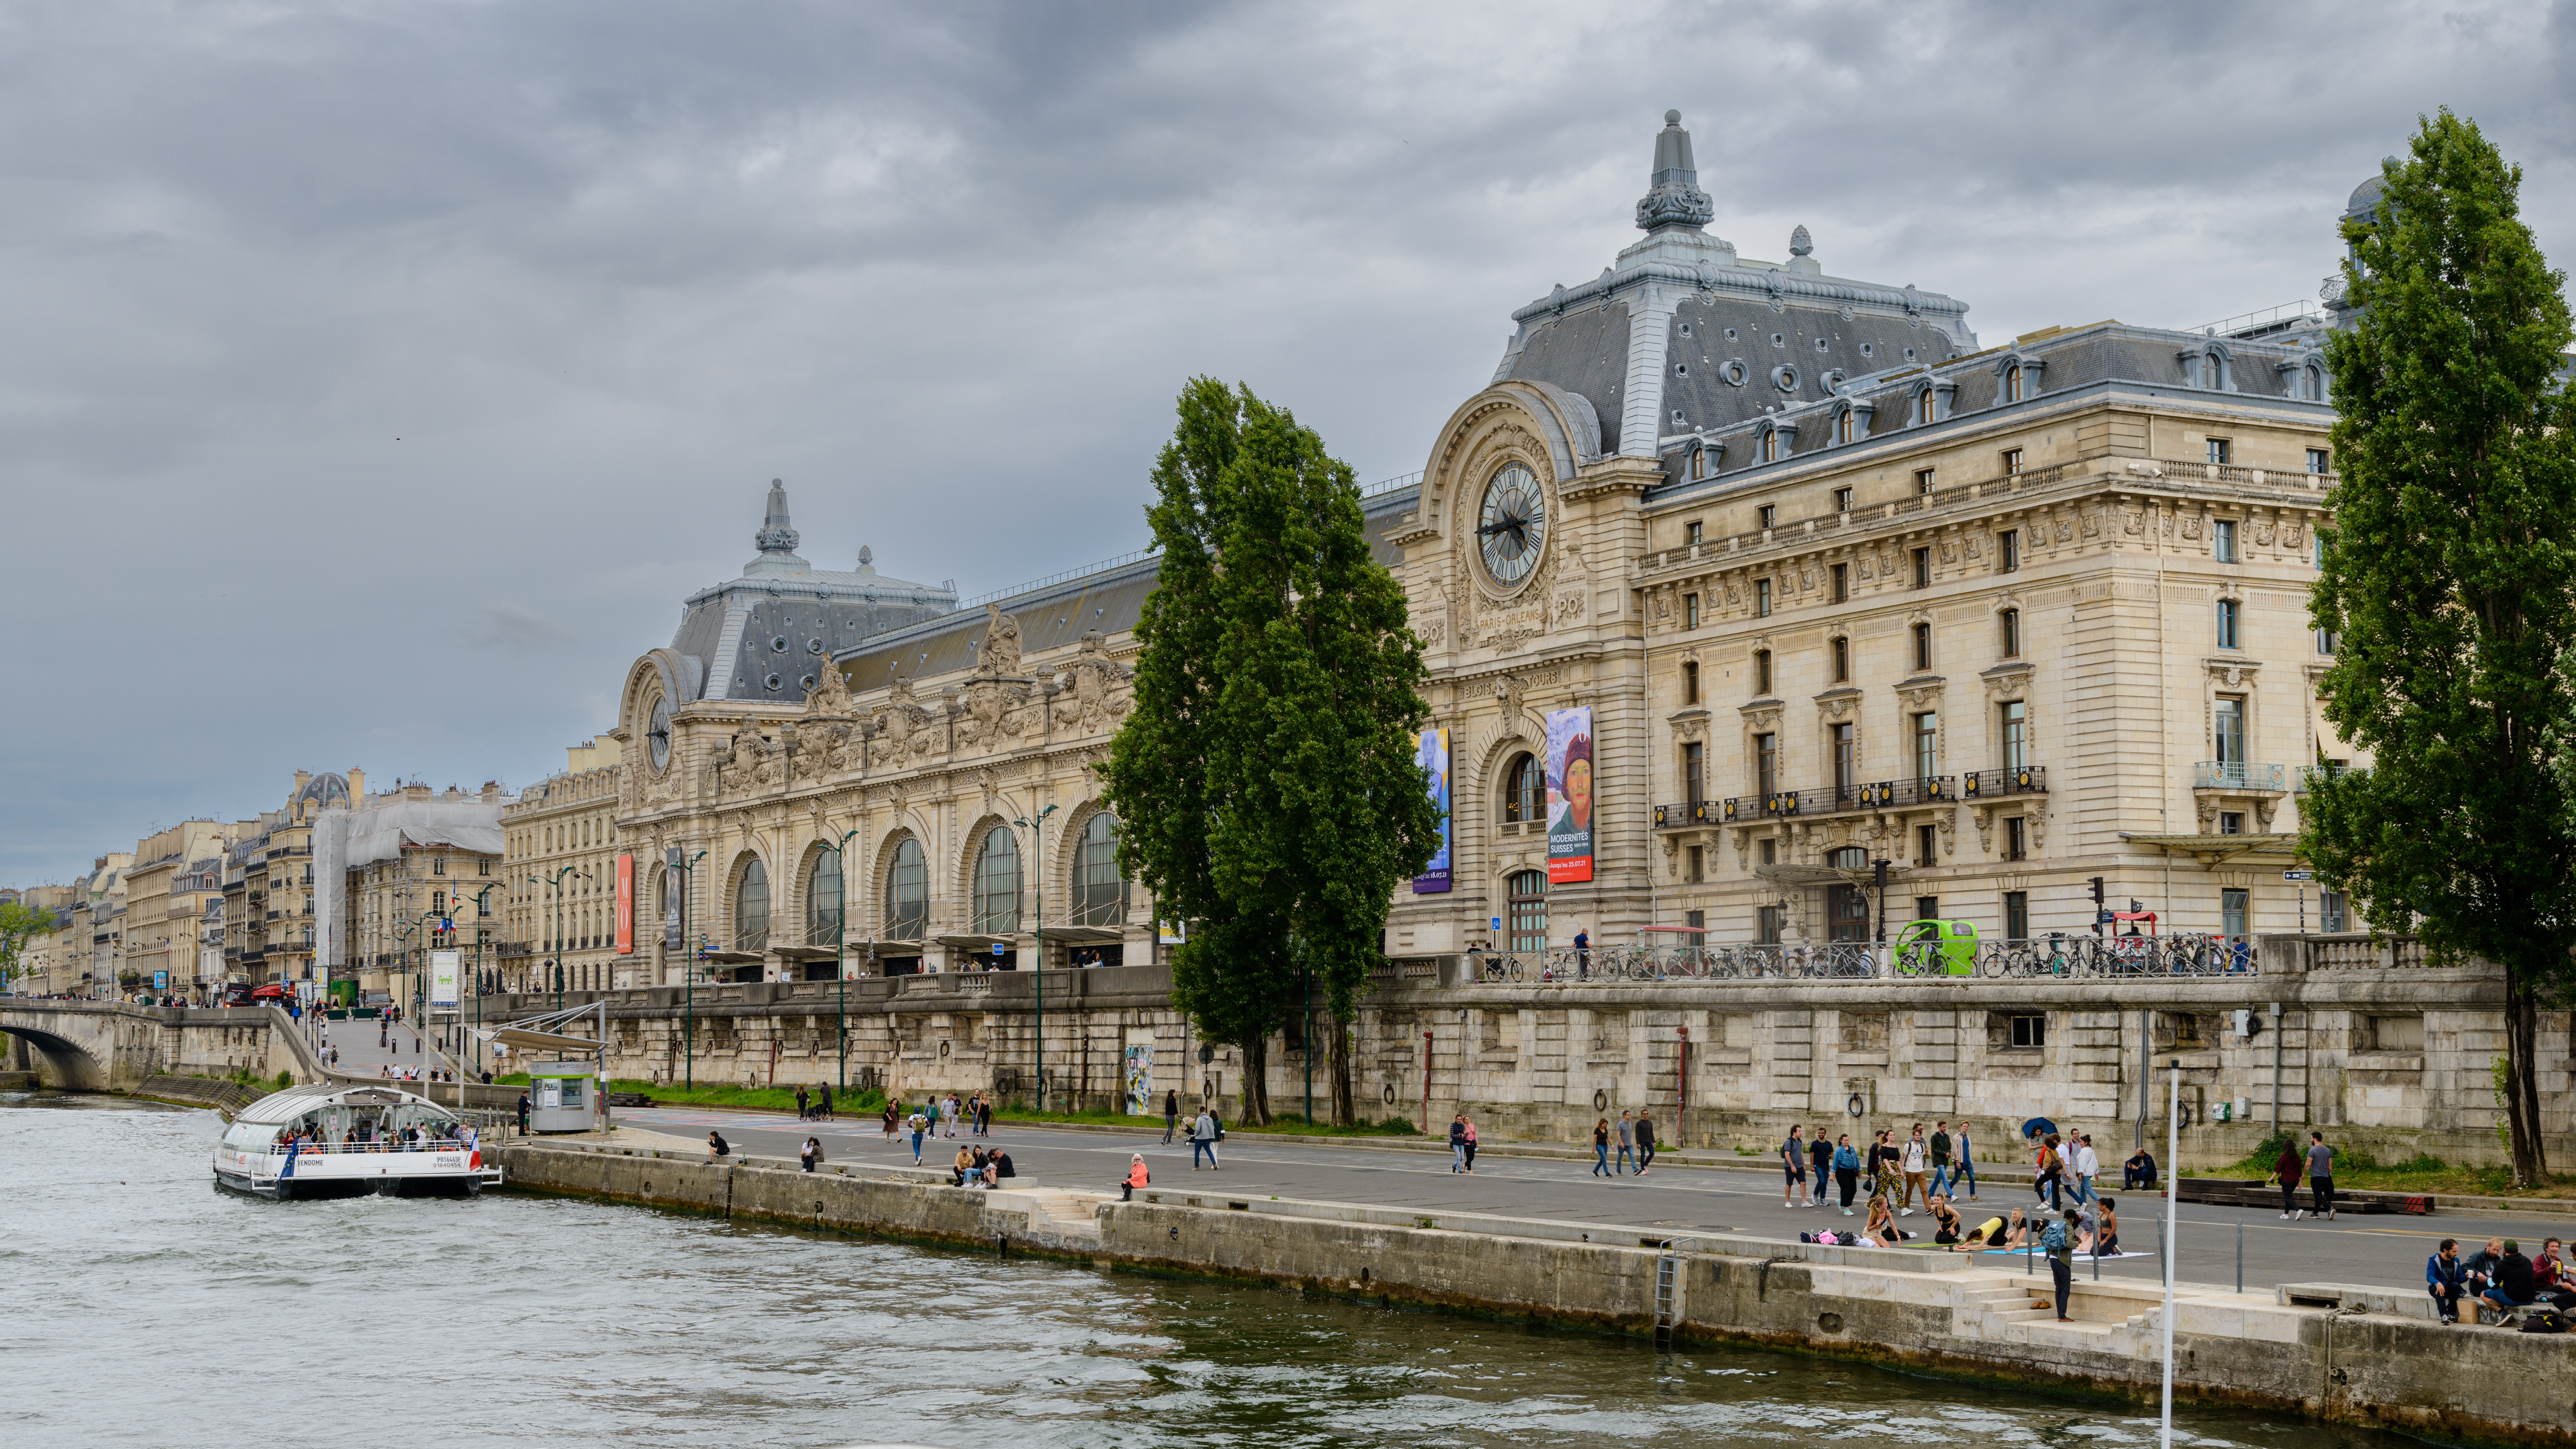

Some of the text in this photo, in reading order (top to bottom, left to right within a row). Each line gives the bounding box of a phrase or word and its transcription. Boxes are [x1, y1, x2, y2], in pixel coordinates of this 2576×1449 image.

[1507, 470, 1516, 488] XII
[1522, 473, 1528, 489] I
[1494, 478, 1504, 498] XI
[1529, 488, 1539, 503] II
[1486, 500, 1496, 514] X
[1533, 511, 1543, 524] III
[1486, 542, 1496, 565] VIII
[1495, 557, 1504, 577] VII
[1510, 561, 1517, 579] VI
[1523, 554, 1530, 570] V
[1480, 609, 1539, 631] PARIS-ORLEANS
[1527, 671, 1558, 687] TOURS
[1465, 683, 1492, 698] BLOIS
[1054, 757, 1077, 769] NANTES
[954, 766, 1026, 786] BORDEAUX TOULOUSE
[869, 782, 931, 800] ORLEANS BOURGES
[792, 797, 847, 813] POITIERS LIMOGES
[1551, 830, 1588, 843] MODERNITÉS
[1551, 844, 1573, 853] SUISSES
[621, 877, 628, 899] M
